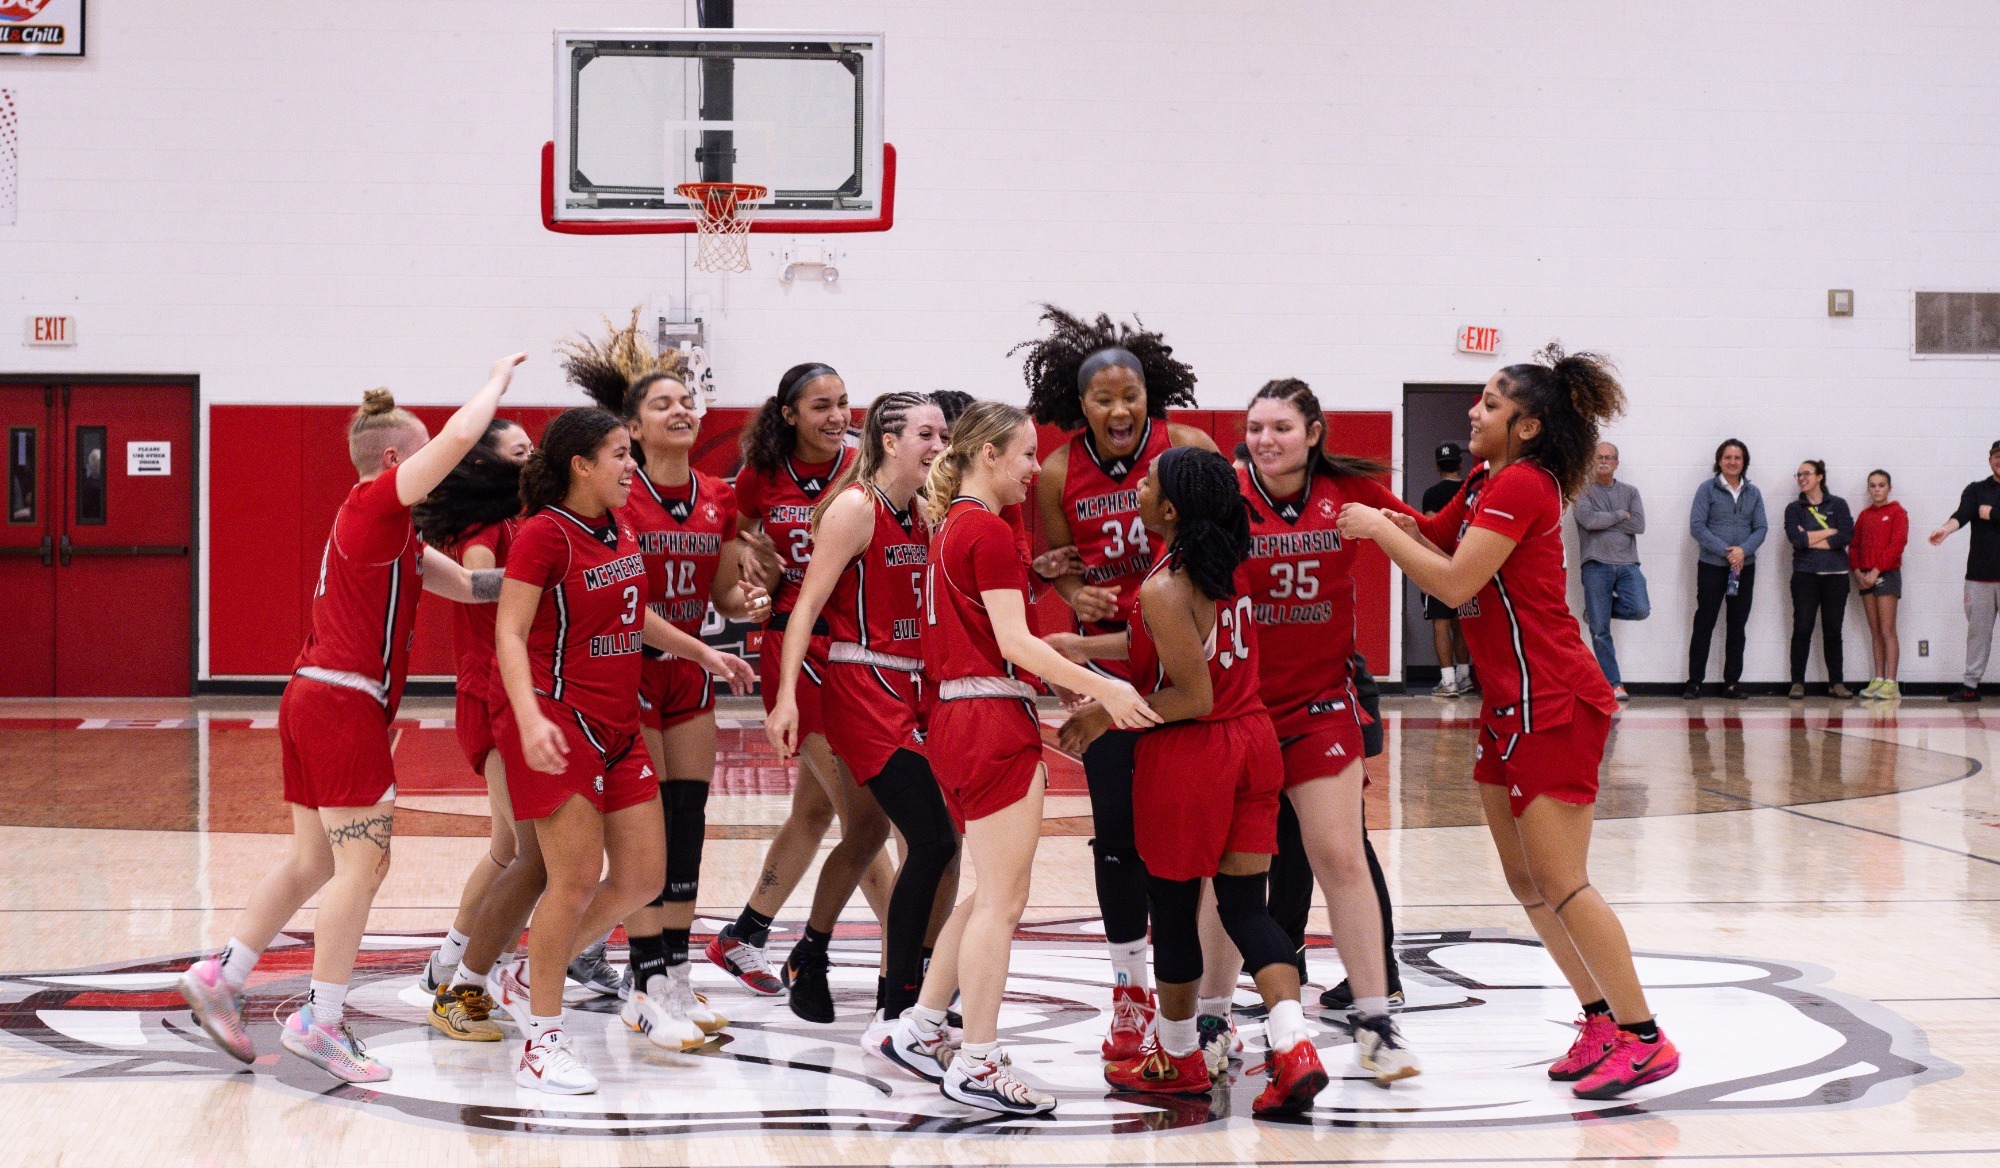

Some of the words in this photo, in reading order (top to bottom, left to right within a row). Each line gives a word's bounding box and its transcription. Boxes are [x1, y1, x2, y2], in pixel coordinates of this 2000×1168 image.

[22, 27, 59, 42] Chill
[35, 317, 67, 340] EXIT
[1466, 326, 1498, 352] EXIT
[769, 505, 816, 523] MCPHE
[1075, 488, 1140, 521] MCPHER
[637, 530, 721, 556] MCPHERSON
[788, 528, 812, 563] 2
[1101, 516, 1151, 559] 34
[884, 543, 928, 567] MCPHERS
[1085, 554, 1154, 585] BULLDO
[583, 552, 647, 591] MCPHERS
[664, 559, 697, 599] 10
[1268, 559, 1321, 601] 35
[620, 585, 639, 625] 3
[590, 630, 643, 657] BULLDO
